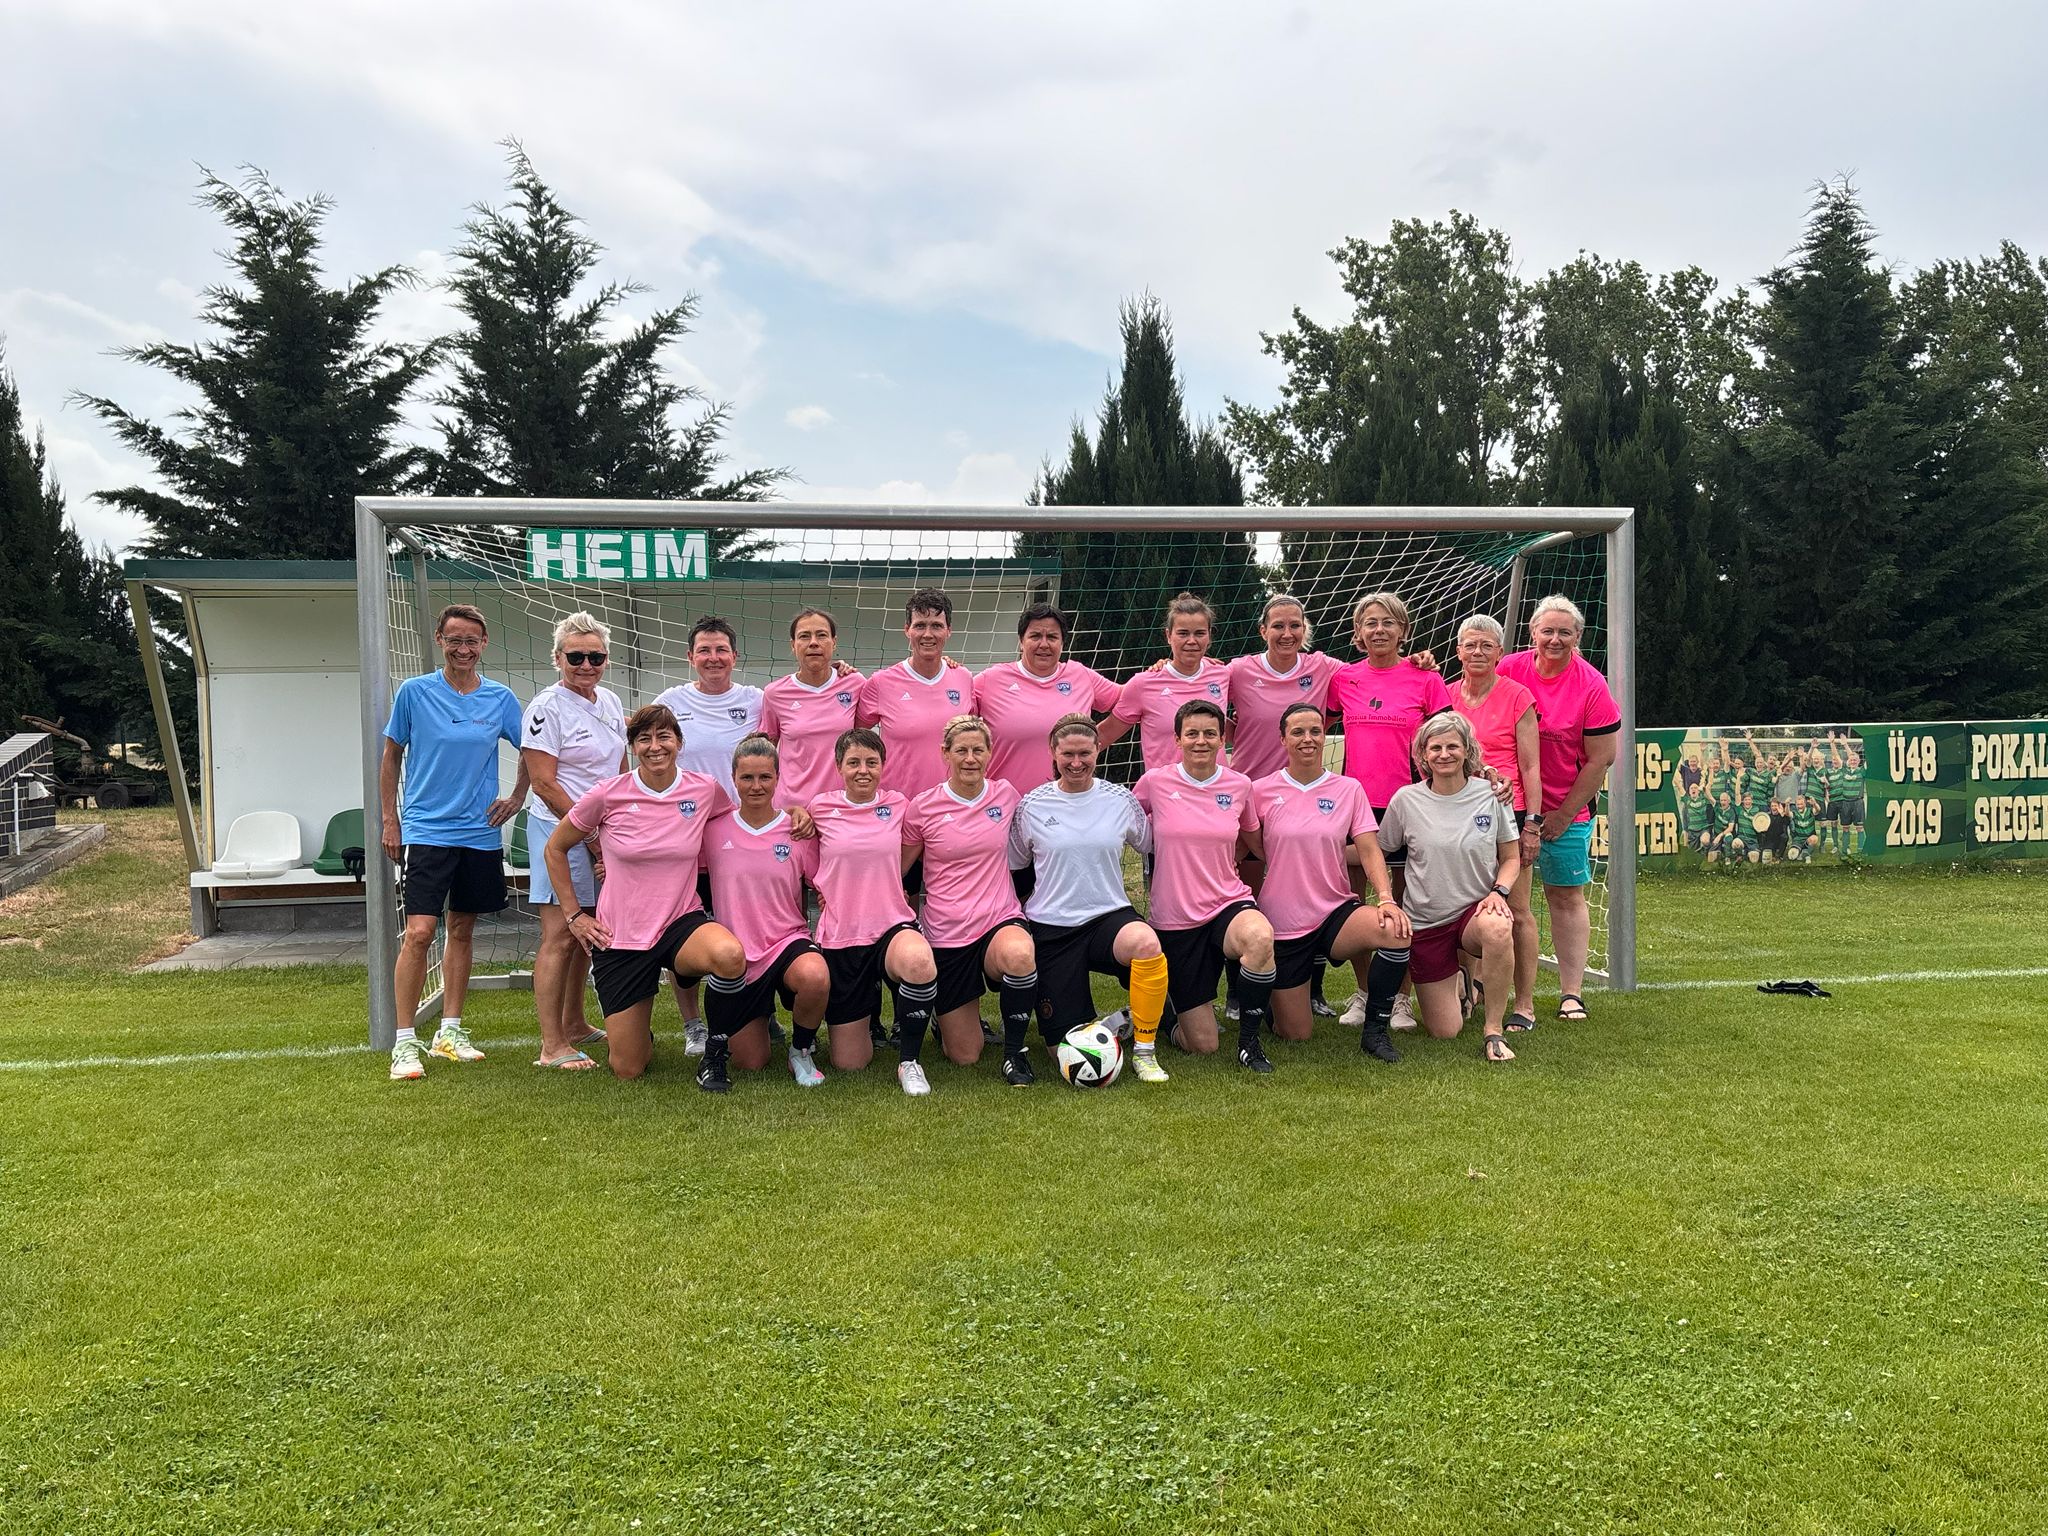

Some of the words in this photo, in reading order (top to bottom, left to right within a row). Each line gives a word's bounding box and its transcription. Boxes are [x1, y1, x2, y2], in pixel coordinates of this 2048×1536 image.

[532, 533, 707, 578] HEIM
[1888, 730, 1937, 782] Ü48
[1886, 798, 1942, 846] 2019
